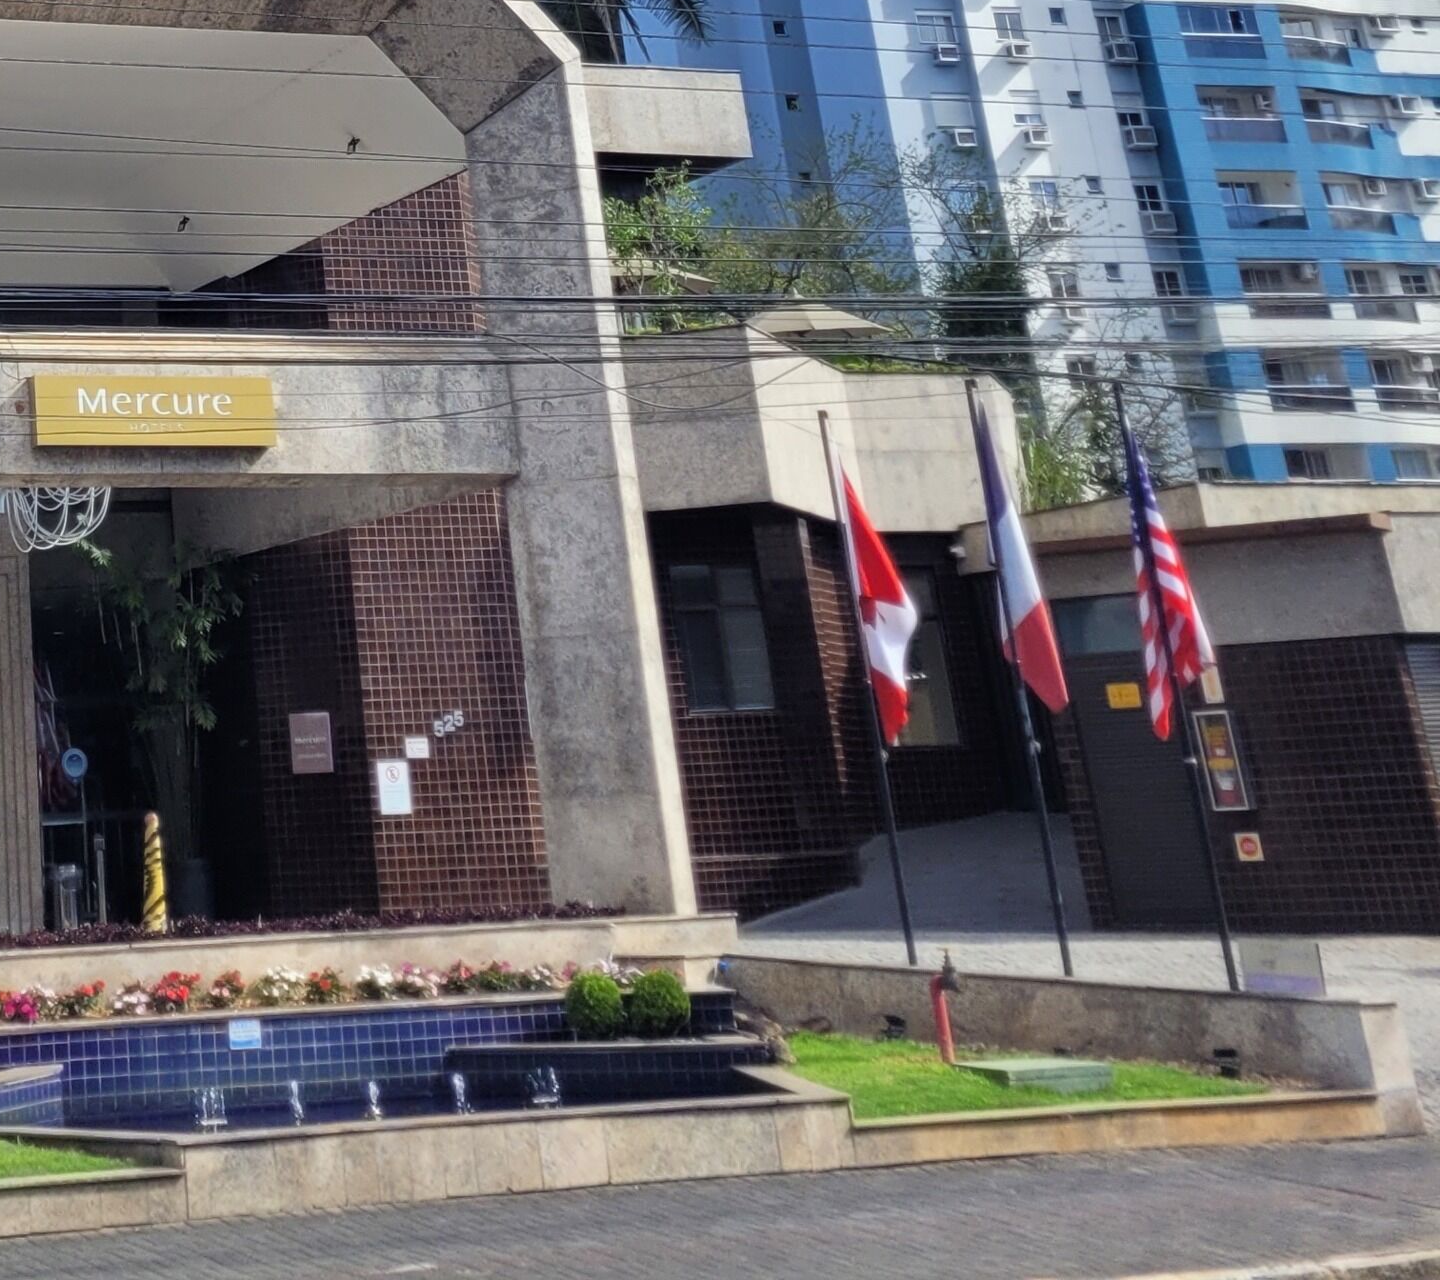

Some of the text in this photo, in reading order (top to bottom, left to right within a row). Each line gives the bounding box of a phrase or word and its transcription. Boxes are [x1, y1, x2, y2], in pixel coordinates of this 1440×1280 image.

[77, 387, 233, 416] Mercure
[129, 422, 186, 433] HOTELS
[433, 710, 466, 738] 525
